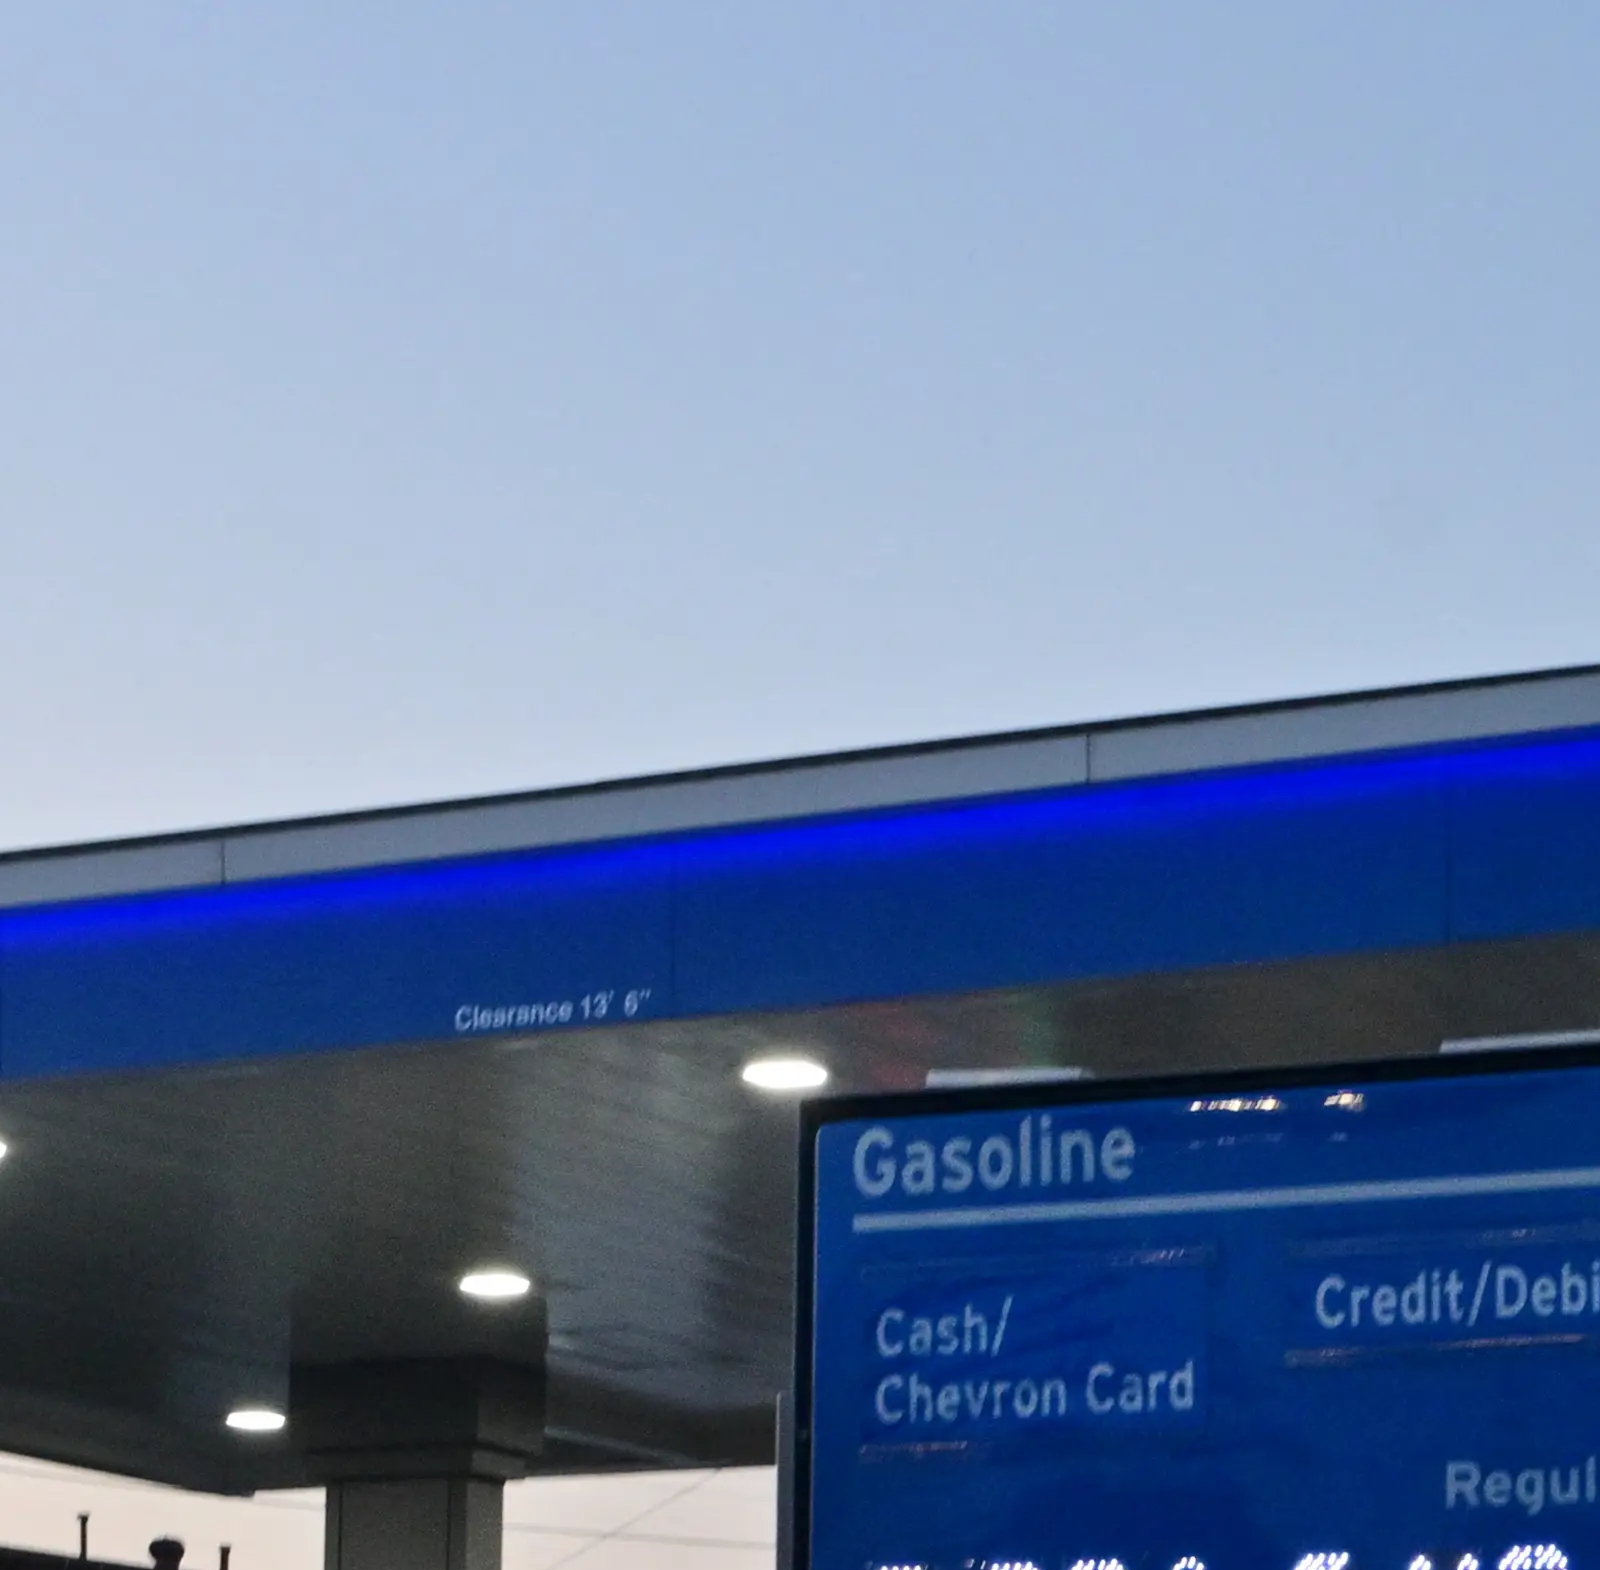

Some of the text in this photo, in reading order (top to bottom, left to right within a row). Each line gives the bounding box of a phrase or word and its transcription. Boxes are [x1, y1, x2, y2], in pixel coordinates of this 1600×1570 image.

[455, 1000, 573, 1031] Clearance
[853, 1114, 1136, 1198] Gasoline
[875, 1296, 1014, 1359] Cash/
[874, 1359, 1194, 1426] Chevron Card
